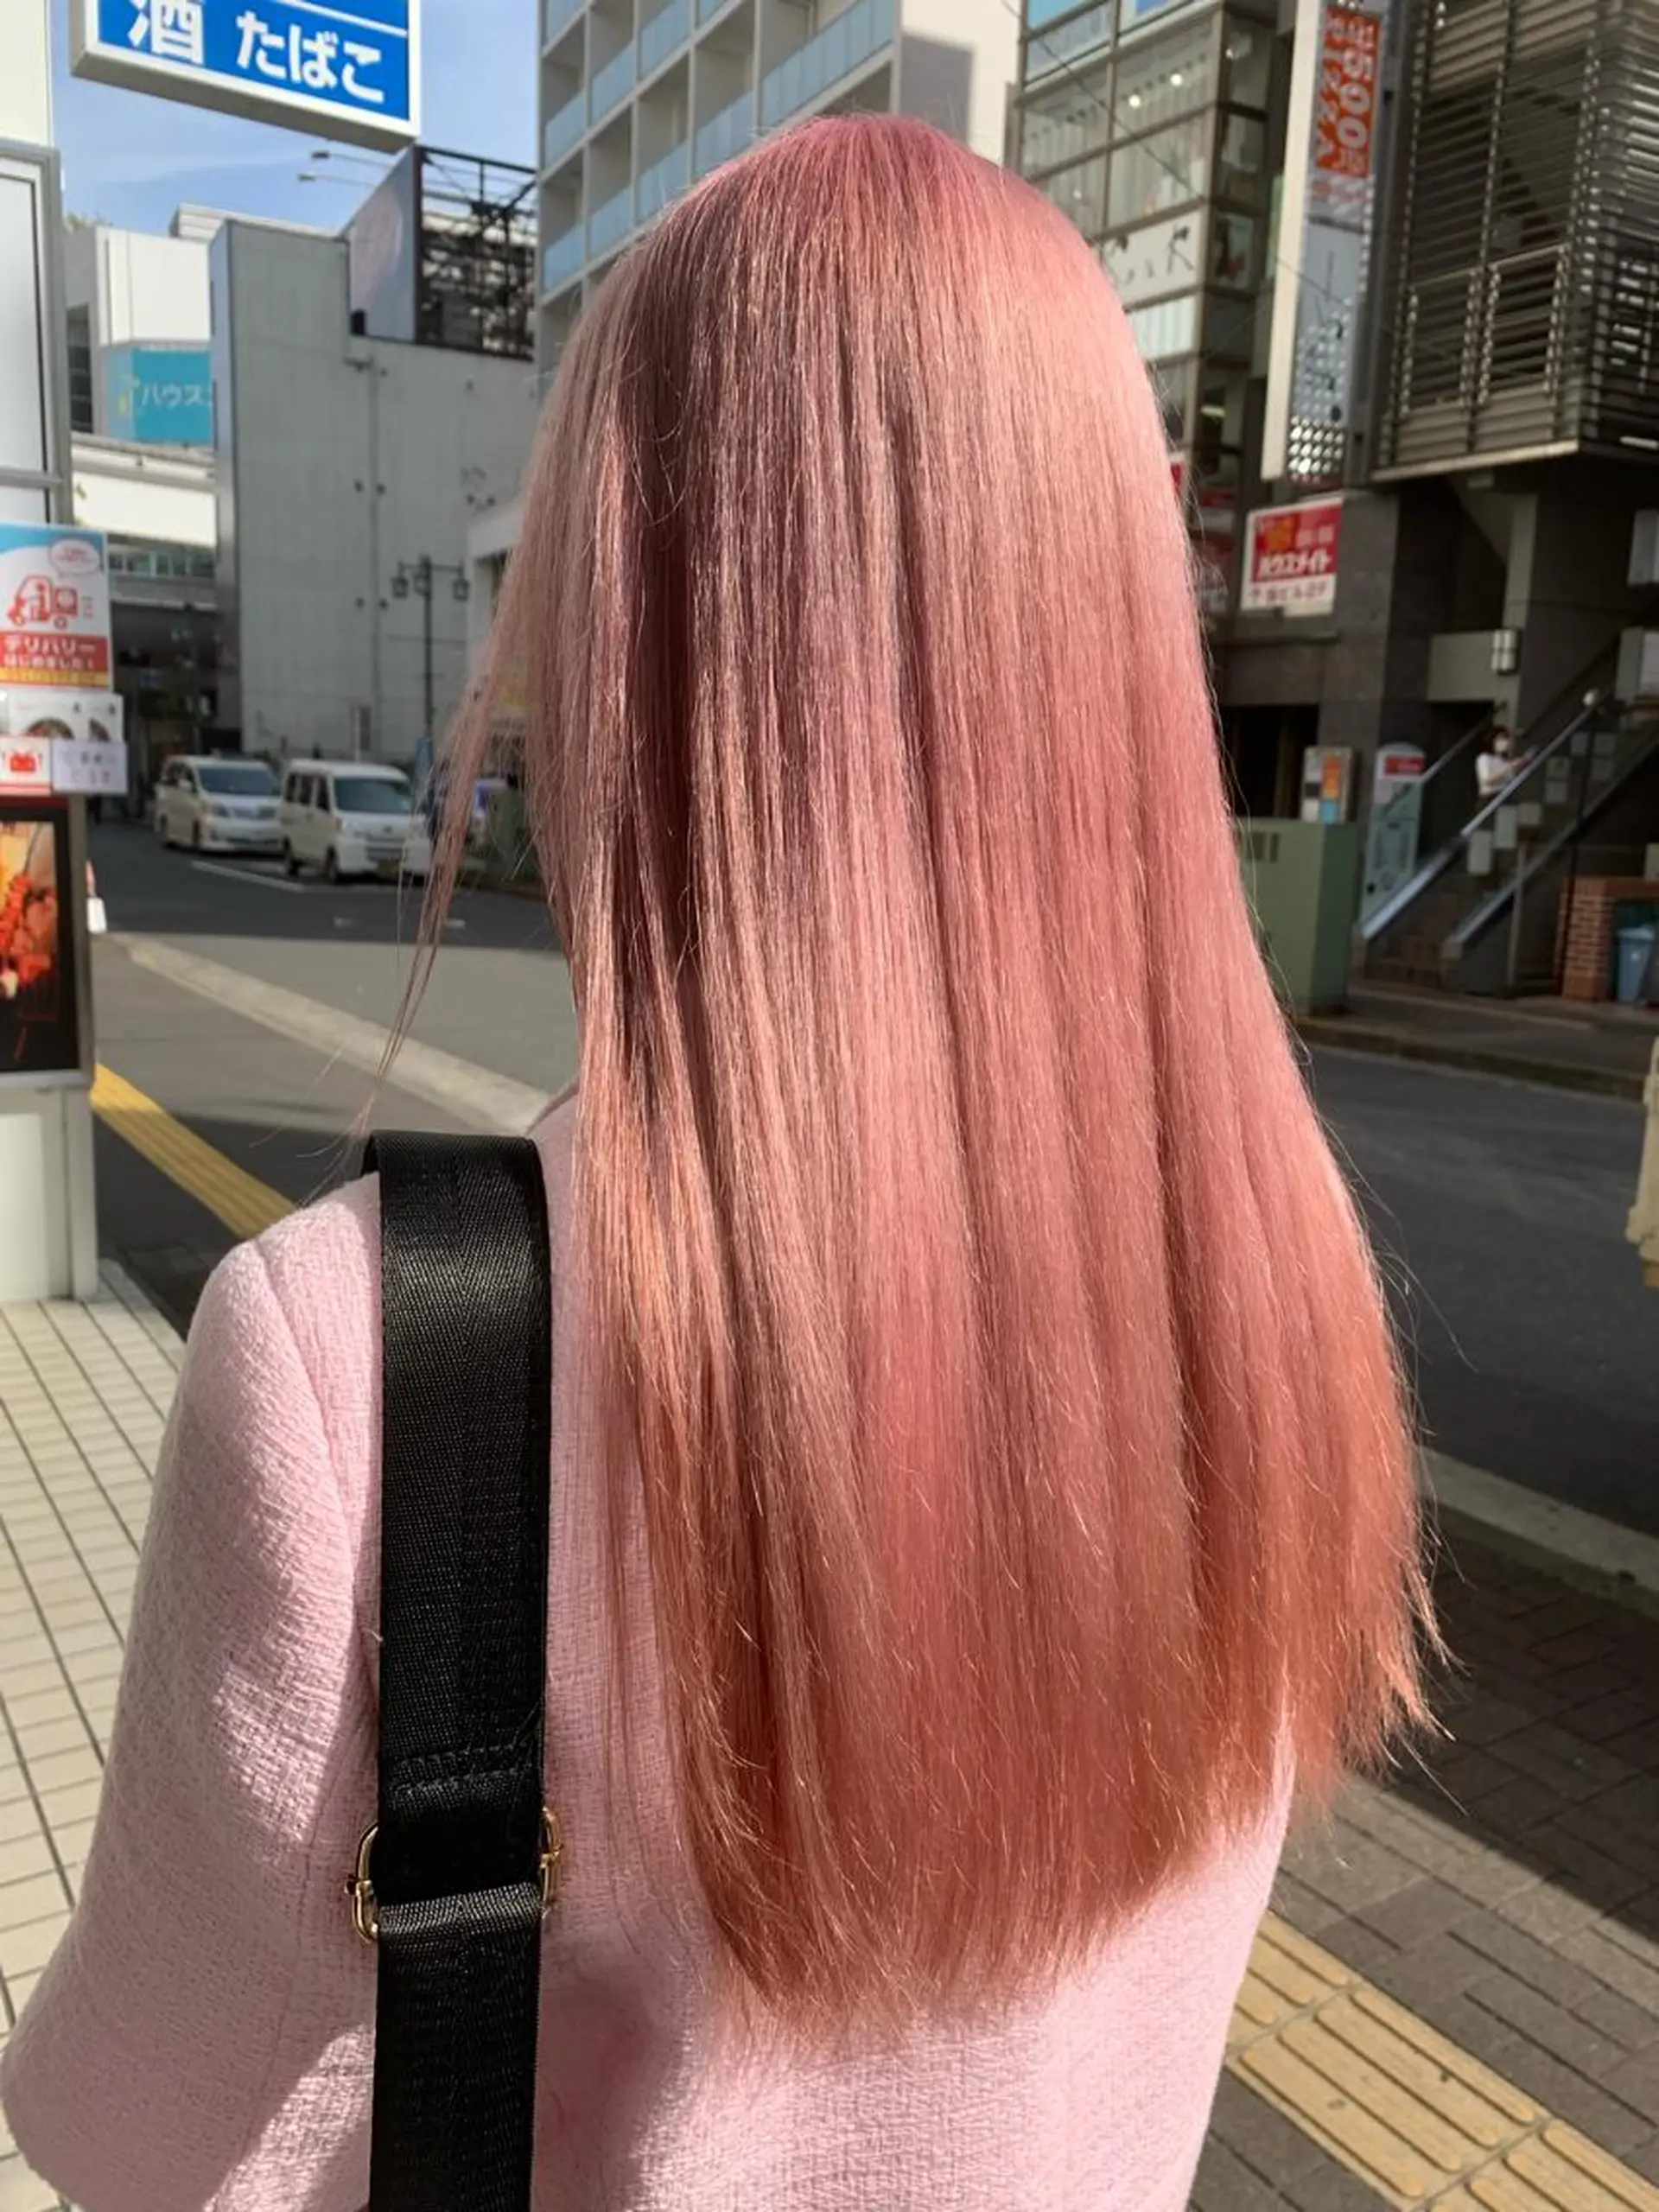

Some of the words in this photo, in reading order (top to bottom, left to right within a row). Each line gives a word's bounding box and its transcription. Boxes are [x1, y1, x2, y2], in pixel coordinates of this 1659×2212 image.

[128, 0, 205, 65] 酒
[236, 10, 385, 103] たばこ
[142, 381, 212, 409] ハウス
